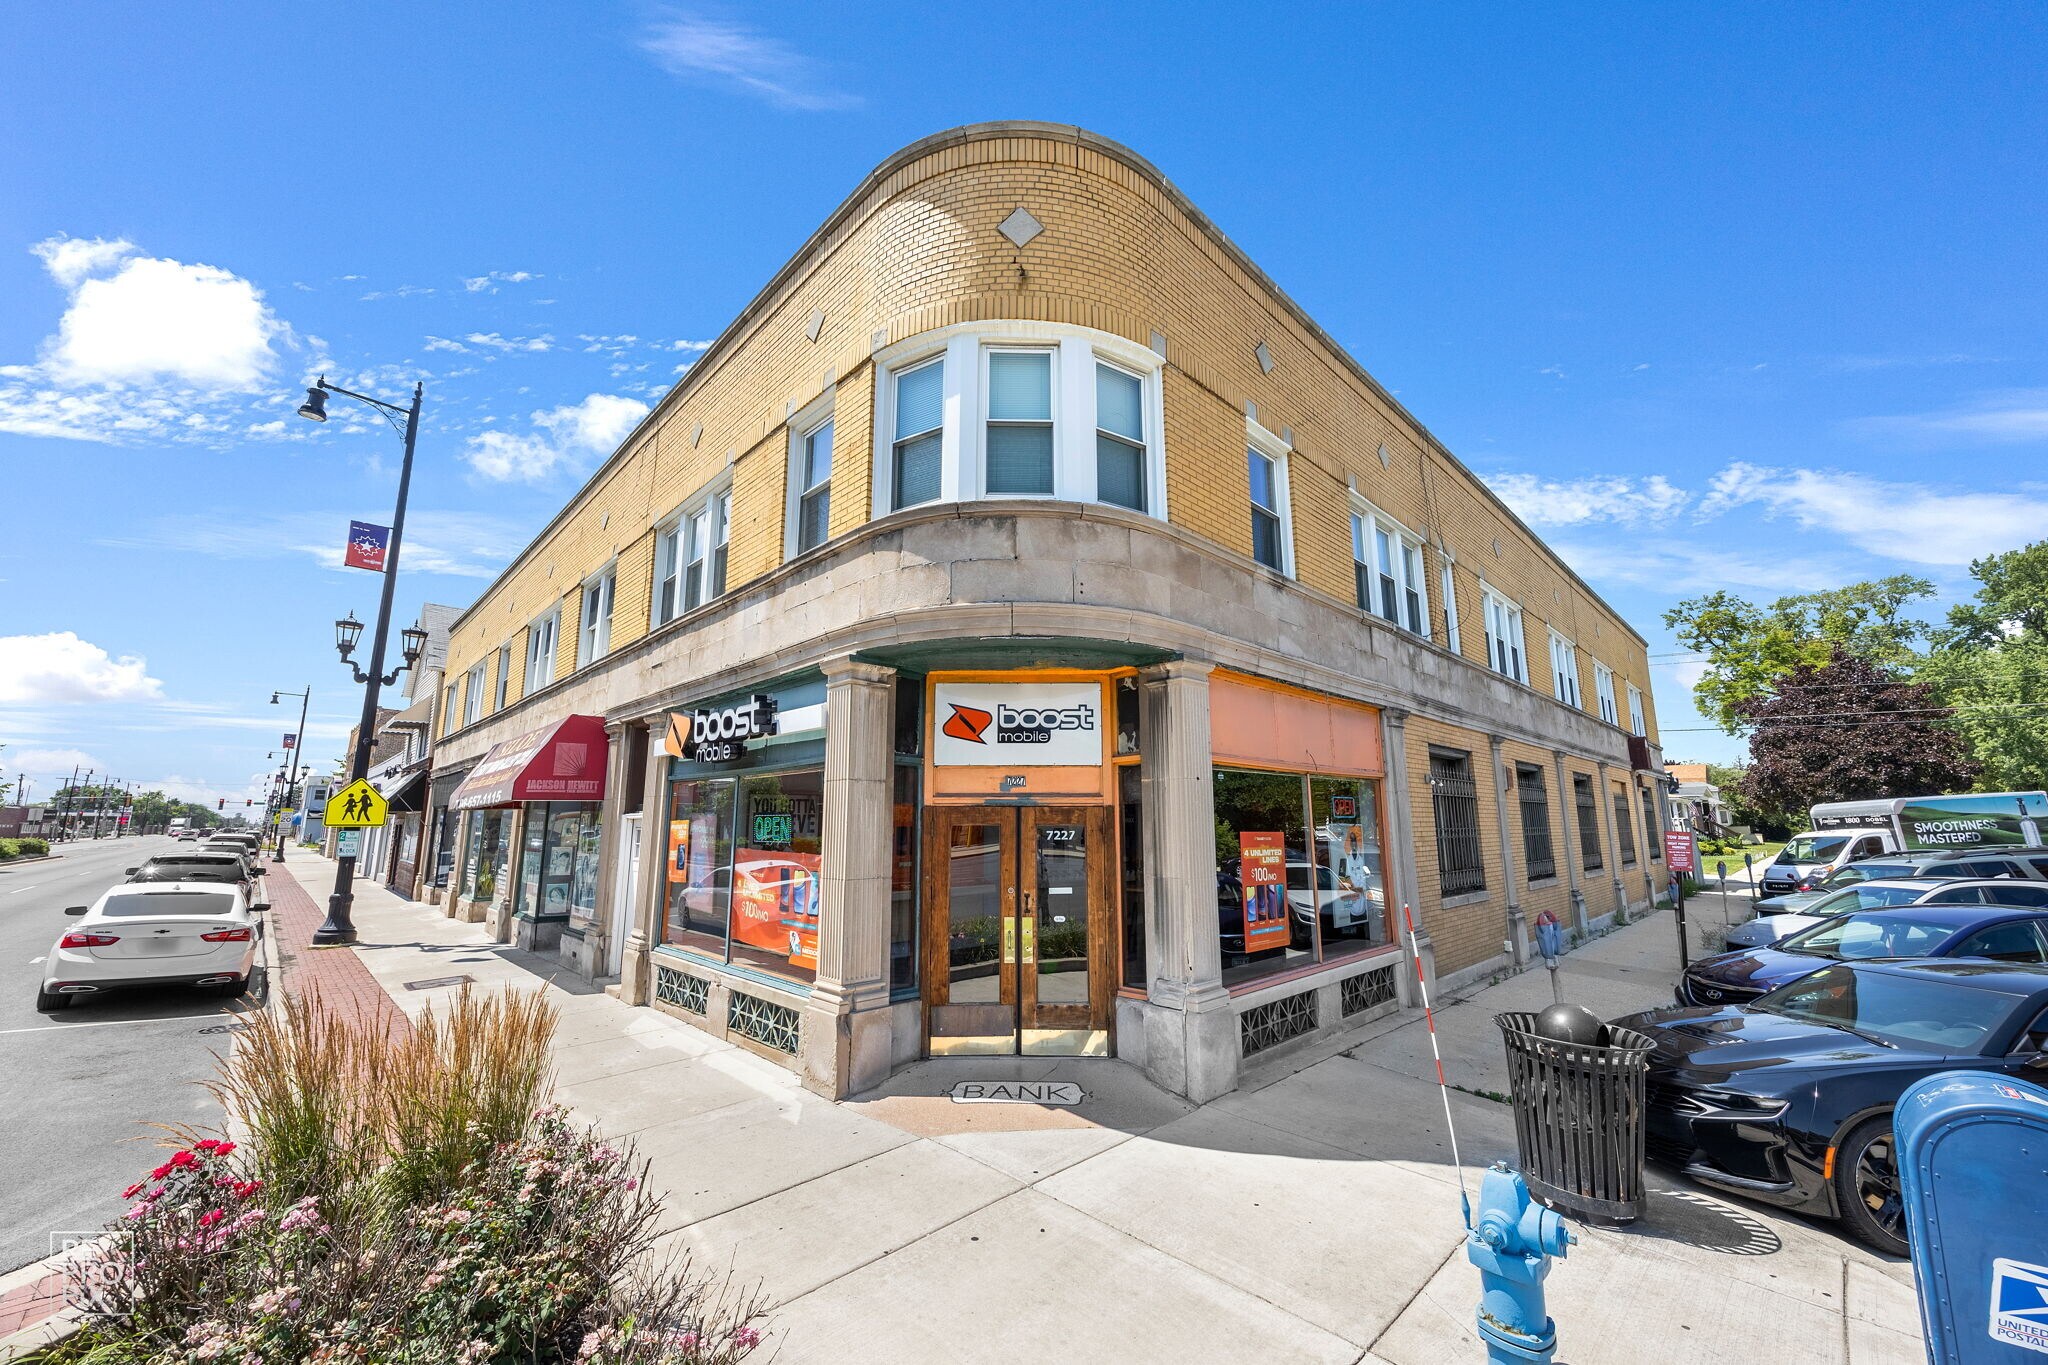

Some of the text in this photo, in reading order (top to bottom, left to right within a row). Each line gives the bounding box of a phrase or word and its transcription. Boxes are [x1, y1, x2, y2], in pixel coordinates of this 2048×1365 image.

[694, 694, 760, 744] boost
[998, 704, 1094, 730] boost
[1000, 731, 1049, 743] mobile
[696, 742, 731, 763] mobile
[526, 779, 600, 791] JACKSON HEWITT
[755, 816, 792, 842] OPEN
[1914, 819, 1998, 833] SMOOTHNESS
[340, 831, 346, 840] 2
[1046, 830, 1076, 841] 7227
[1917, 831, 1981, 845] MASTERED
[963, 1085, 1069, 1100] BANK
[1998, 1318, 2048, 1338] UNITED
[1997, 1328, 2048, 1348] POSTAL
